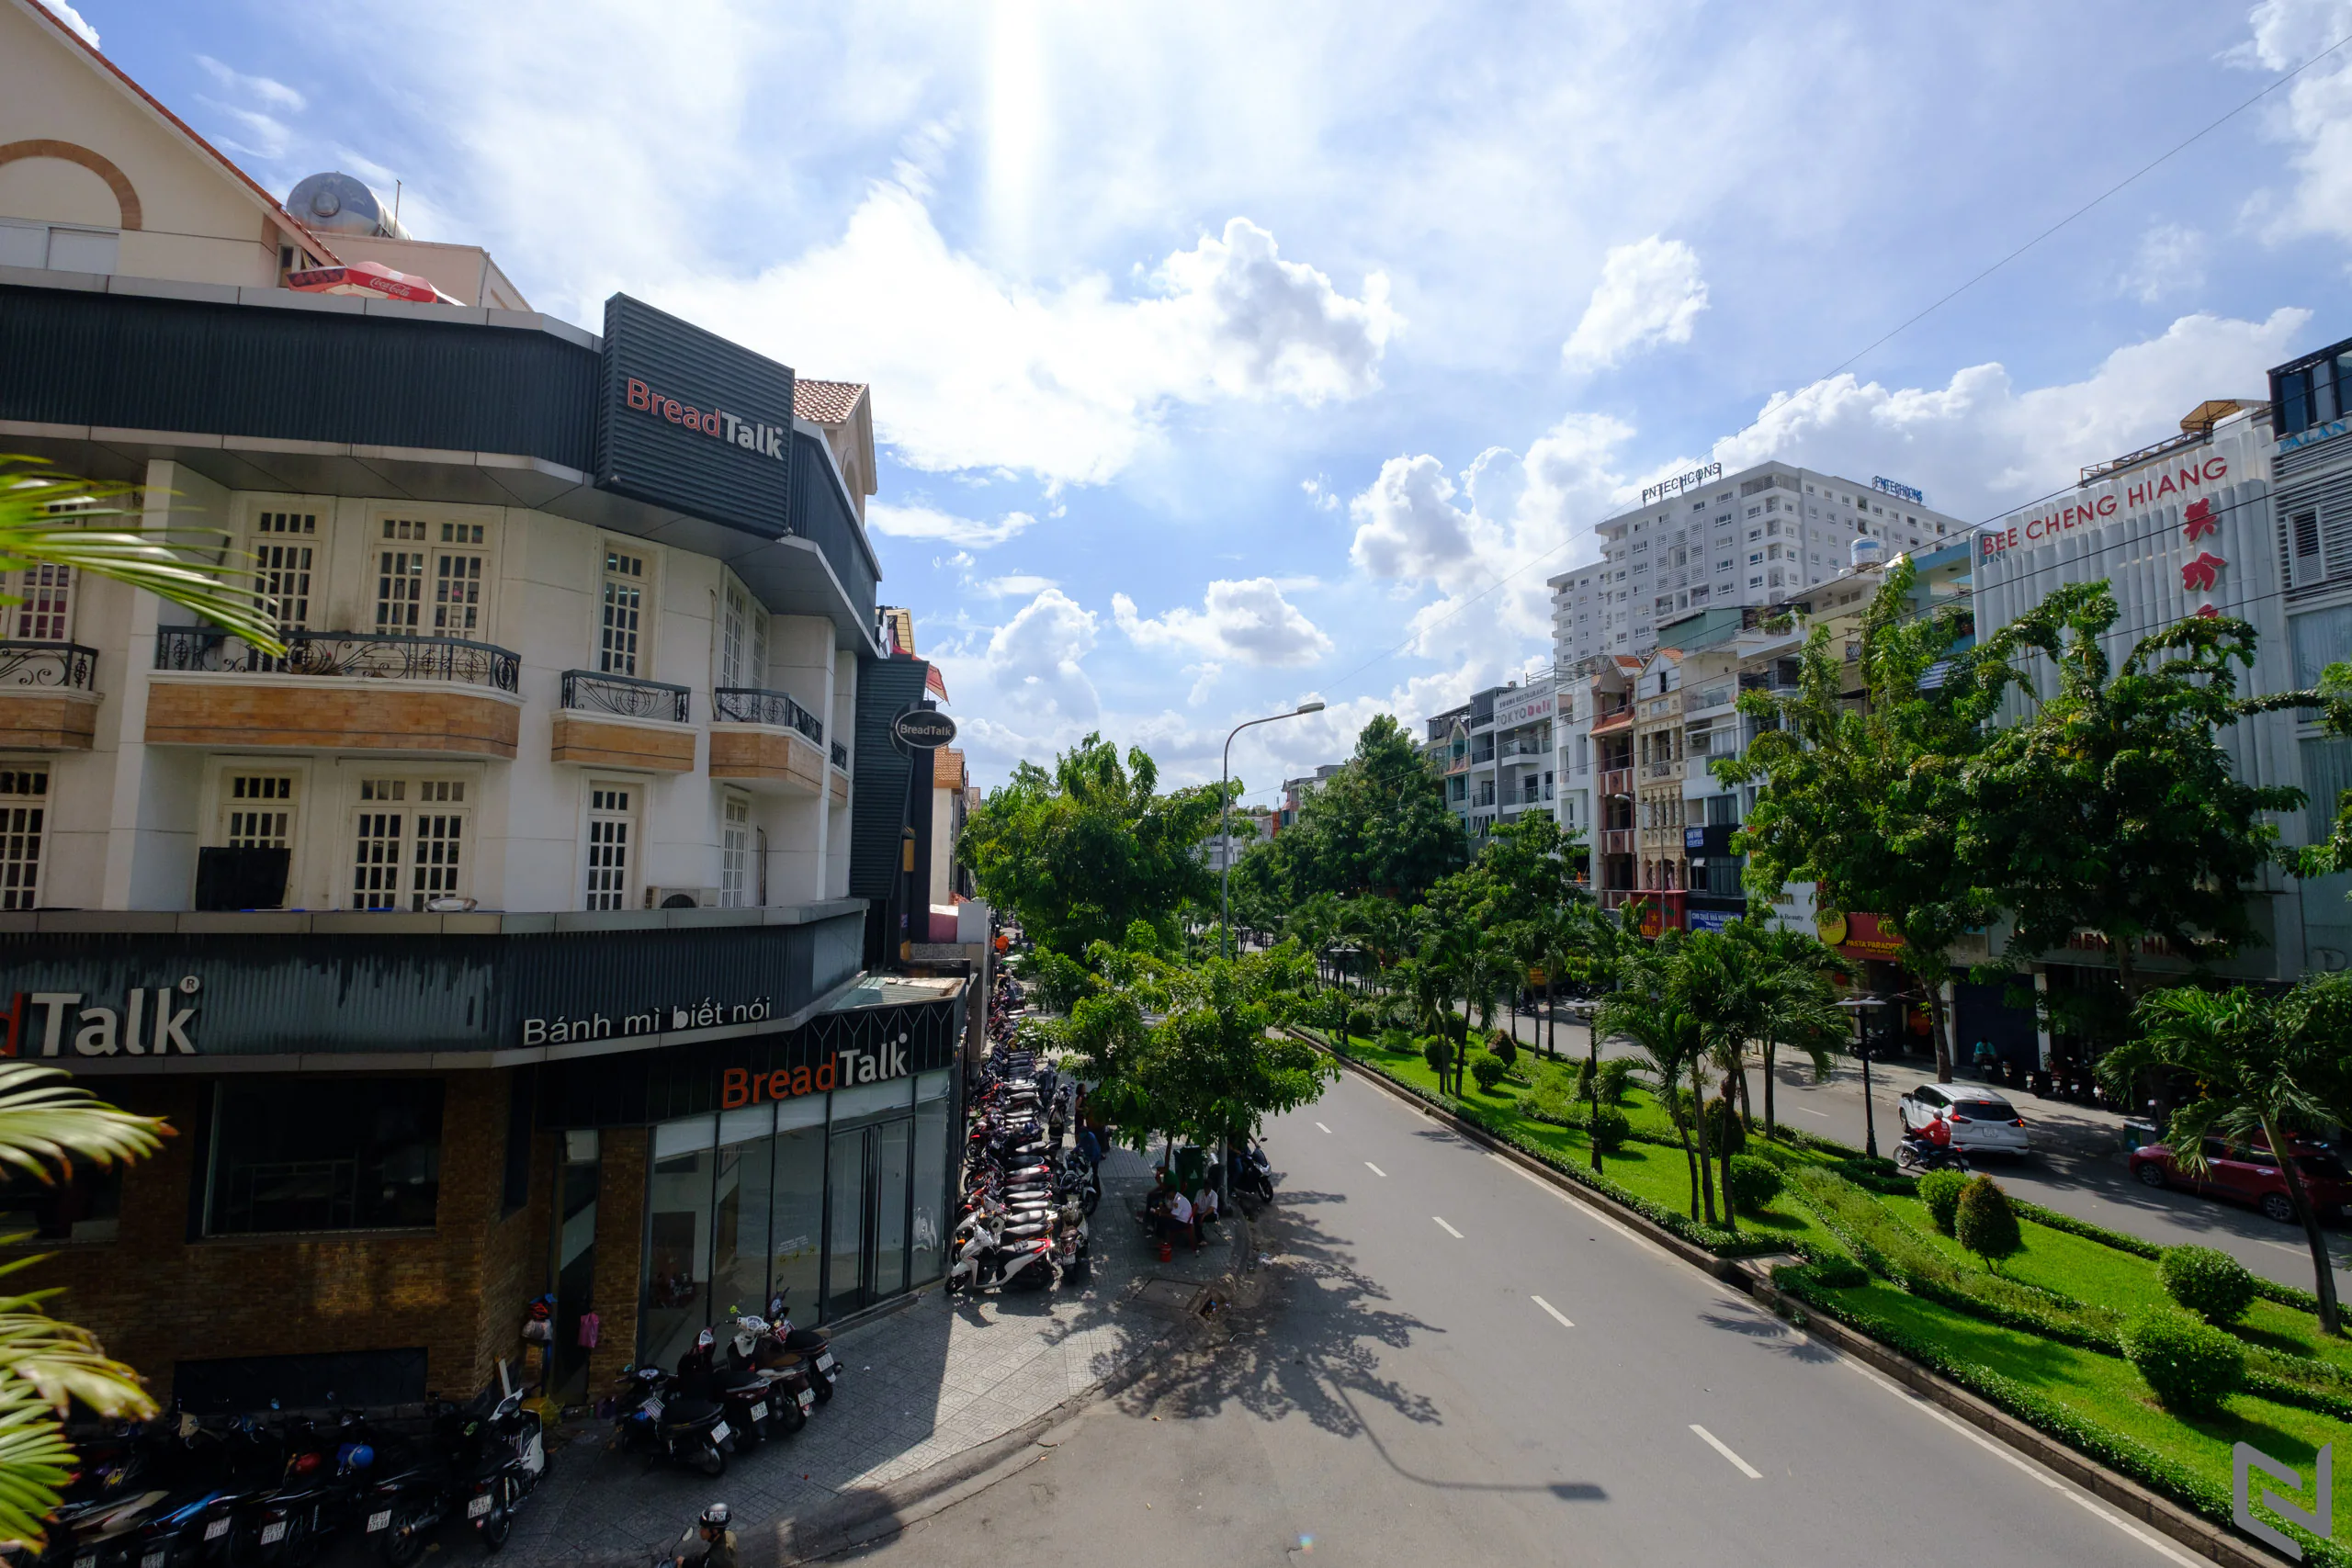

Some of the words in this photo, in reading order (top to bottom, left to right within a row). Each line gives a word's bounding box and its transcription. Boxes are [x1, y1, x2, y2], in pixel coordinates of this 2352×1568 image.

[369, 276, 413, 298] Coca-Cola
[628, 377, 784, 461] BreadTalk
[1642, 462, 1722, 502] PNTECHCONS
[1983, 527, 2018, 556] BEE
[2026, 494, 2118, 540] CHENG
[2128, 457, 2228, 508] HIANG
[900, 724, 952, 737] BreadTalk
[1784, 913, 1804, 922] Beauty
[1846, 939, 1867, 948] PASTA
[523, 1012, 611, 1046] Bánh
[623, 1006, 661, 1035] mì
[673, 996, 724, 1030] biết
[732, 996, 771, 1021] nói
[722, 1036, 908, 1110] BreadTalk
